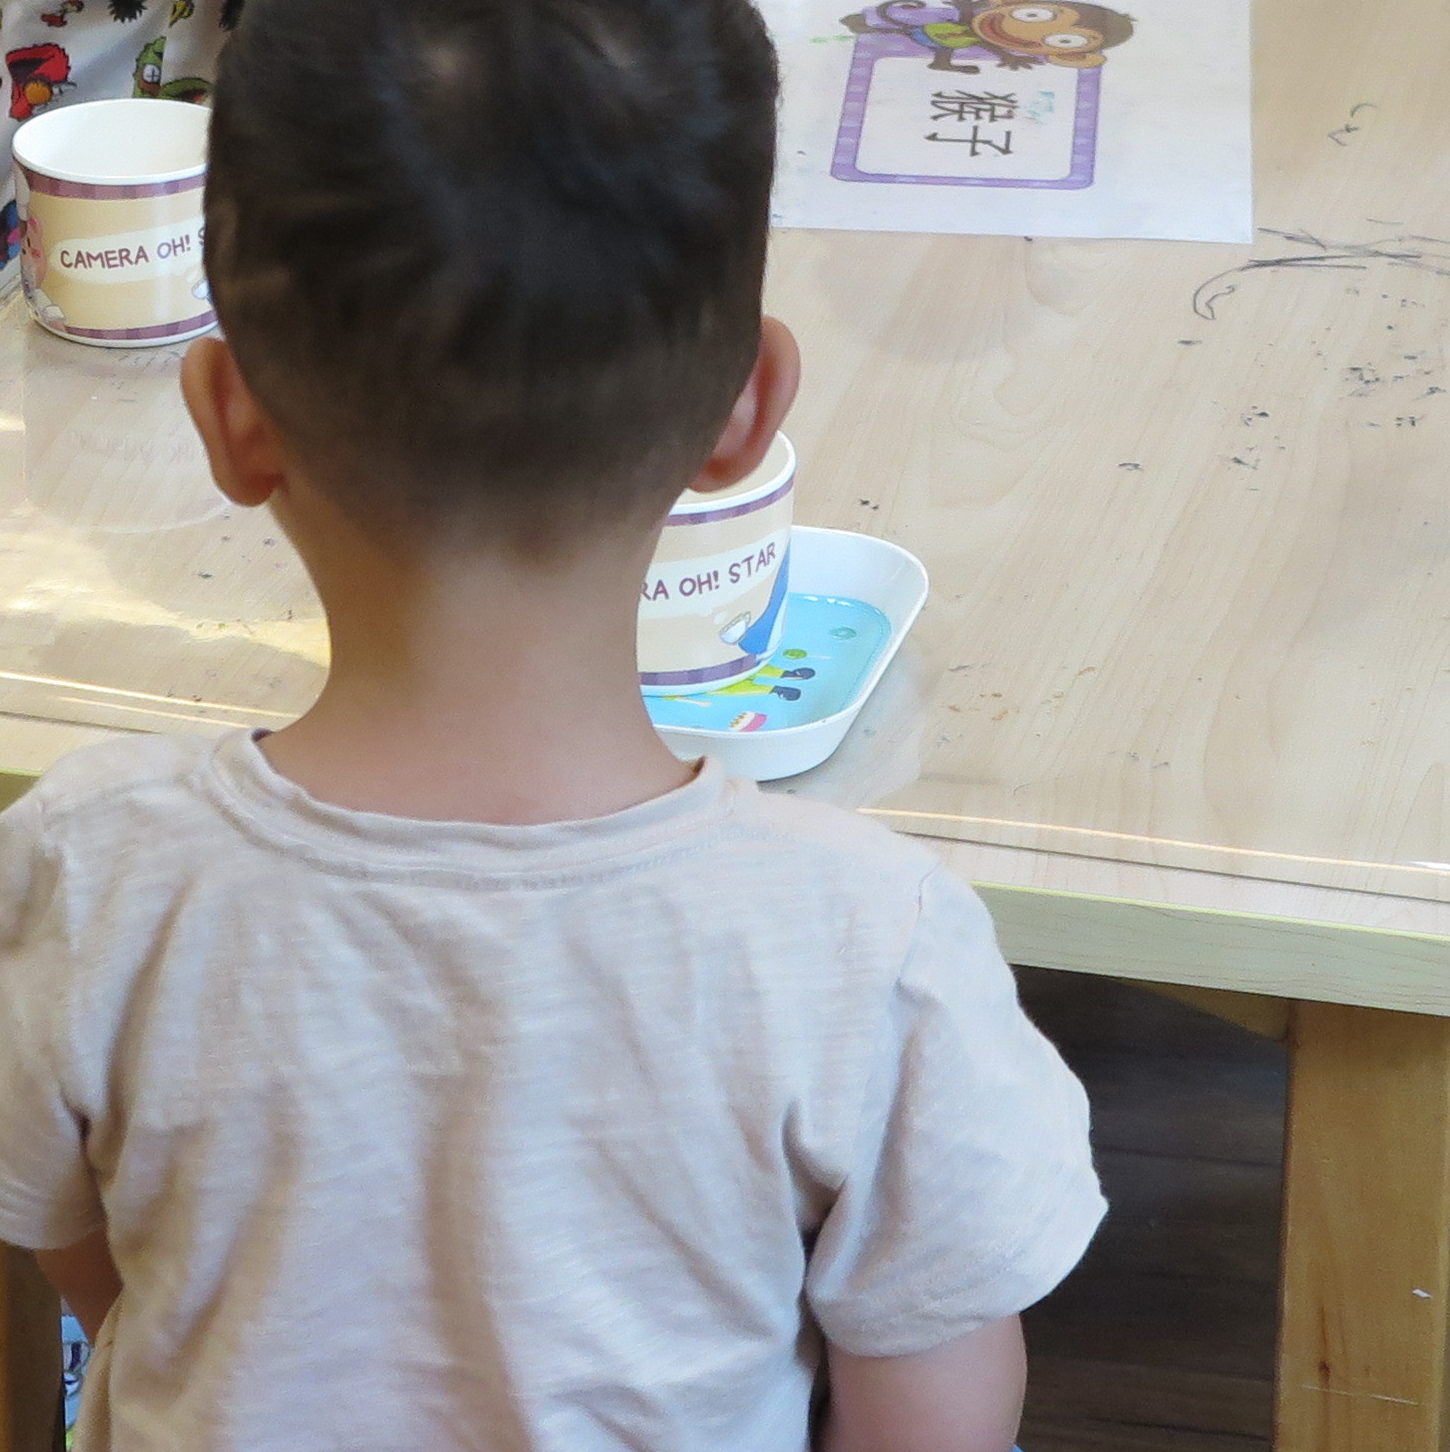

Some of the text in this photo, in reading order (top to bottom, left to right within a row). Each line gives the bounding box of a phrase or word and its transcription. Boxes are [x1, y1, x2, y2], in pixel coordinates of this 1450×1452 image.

[924, 89, 1019, 157] 猴子
[60, 245, 150, 269] CAMERA
[156, 234, 191, 259] OH!
[678, 569, 720, 597] OH!
[728, 541, 776, 584] STAR
